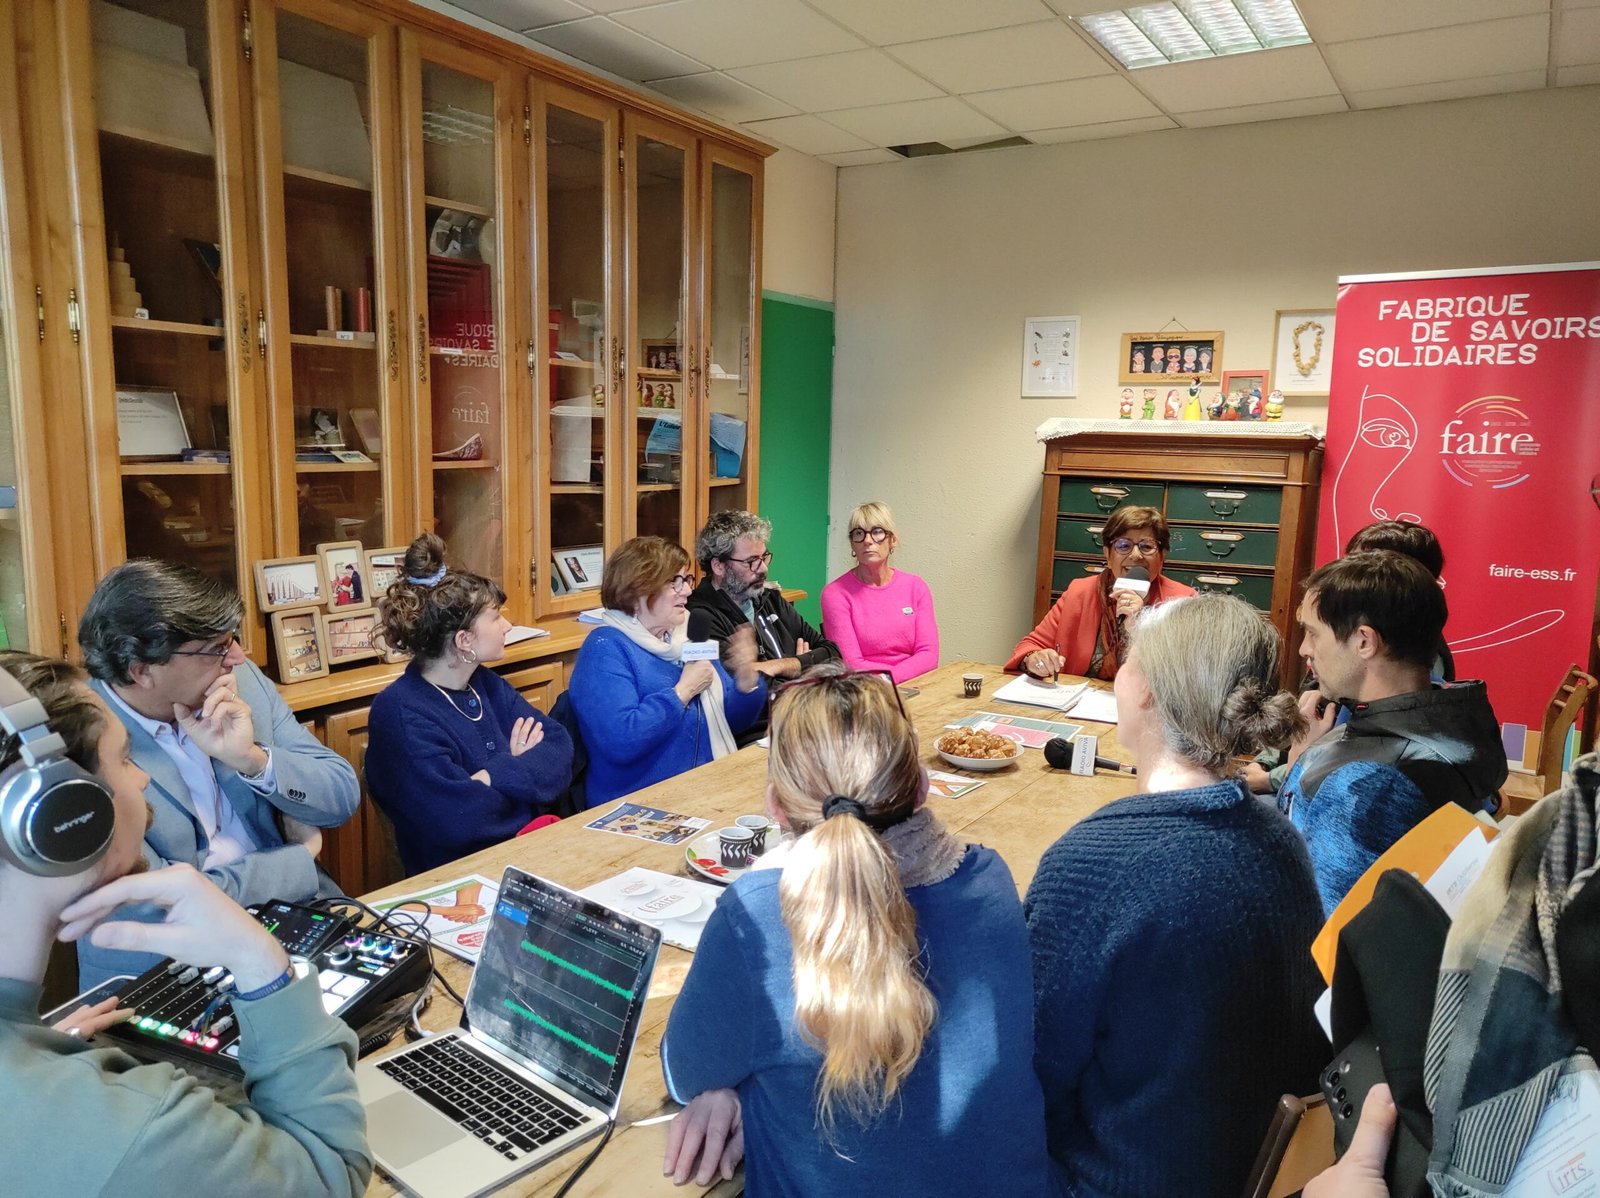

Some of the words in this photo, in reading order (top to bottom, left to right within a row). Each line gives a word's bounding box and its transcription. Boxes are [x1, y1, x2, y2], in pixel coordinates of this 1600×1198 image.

[1378, 293, 1531, 321] FABRIQUE
[1411, 320, 1452, 343] DE
[1469, 316, 1600, 342] SAVOIRS
[1357, 343, 1539, 368] SOLIDAIRES
[1438, 420, 1535, 455] faire
[1489, 563, 1577, 582] faire-ess.fr
[53, 811, 95, 833] behringer
